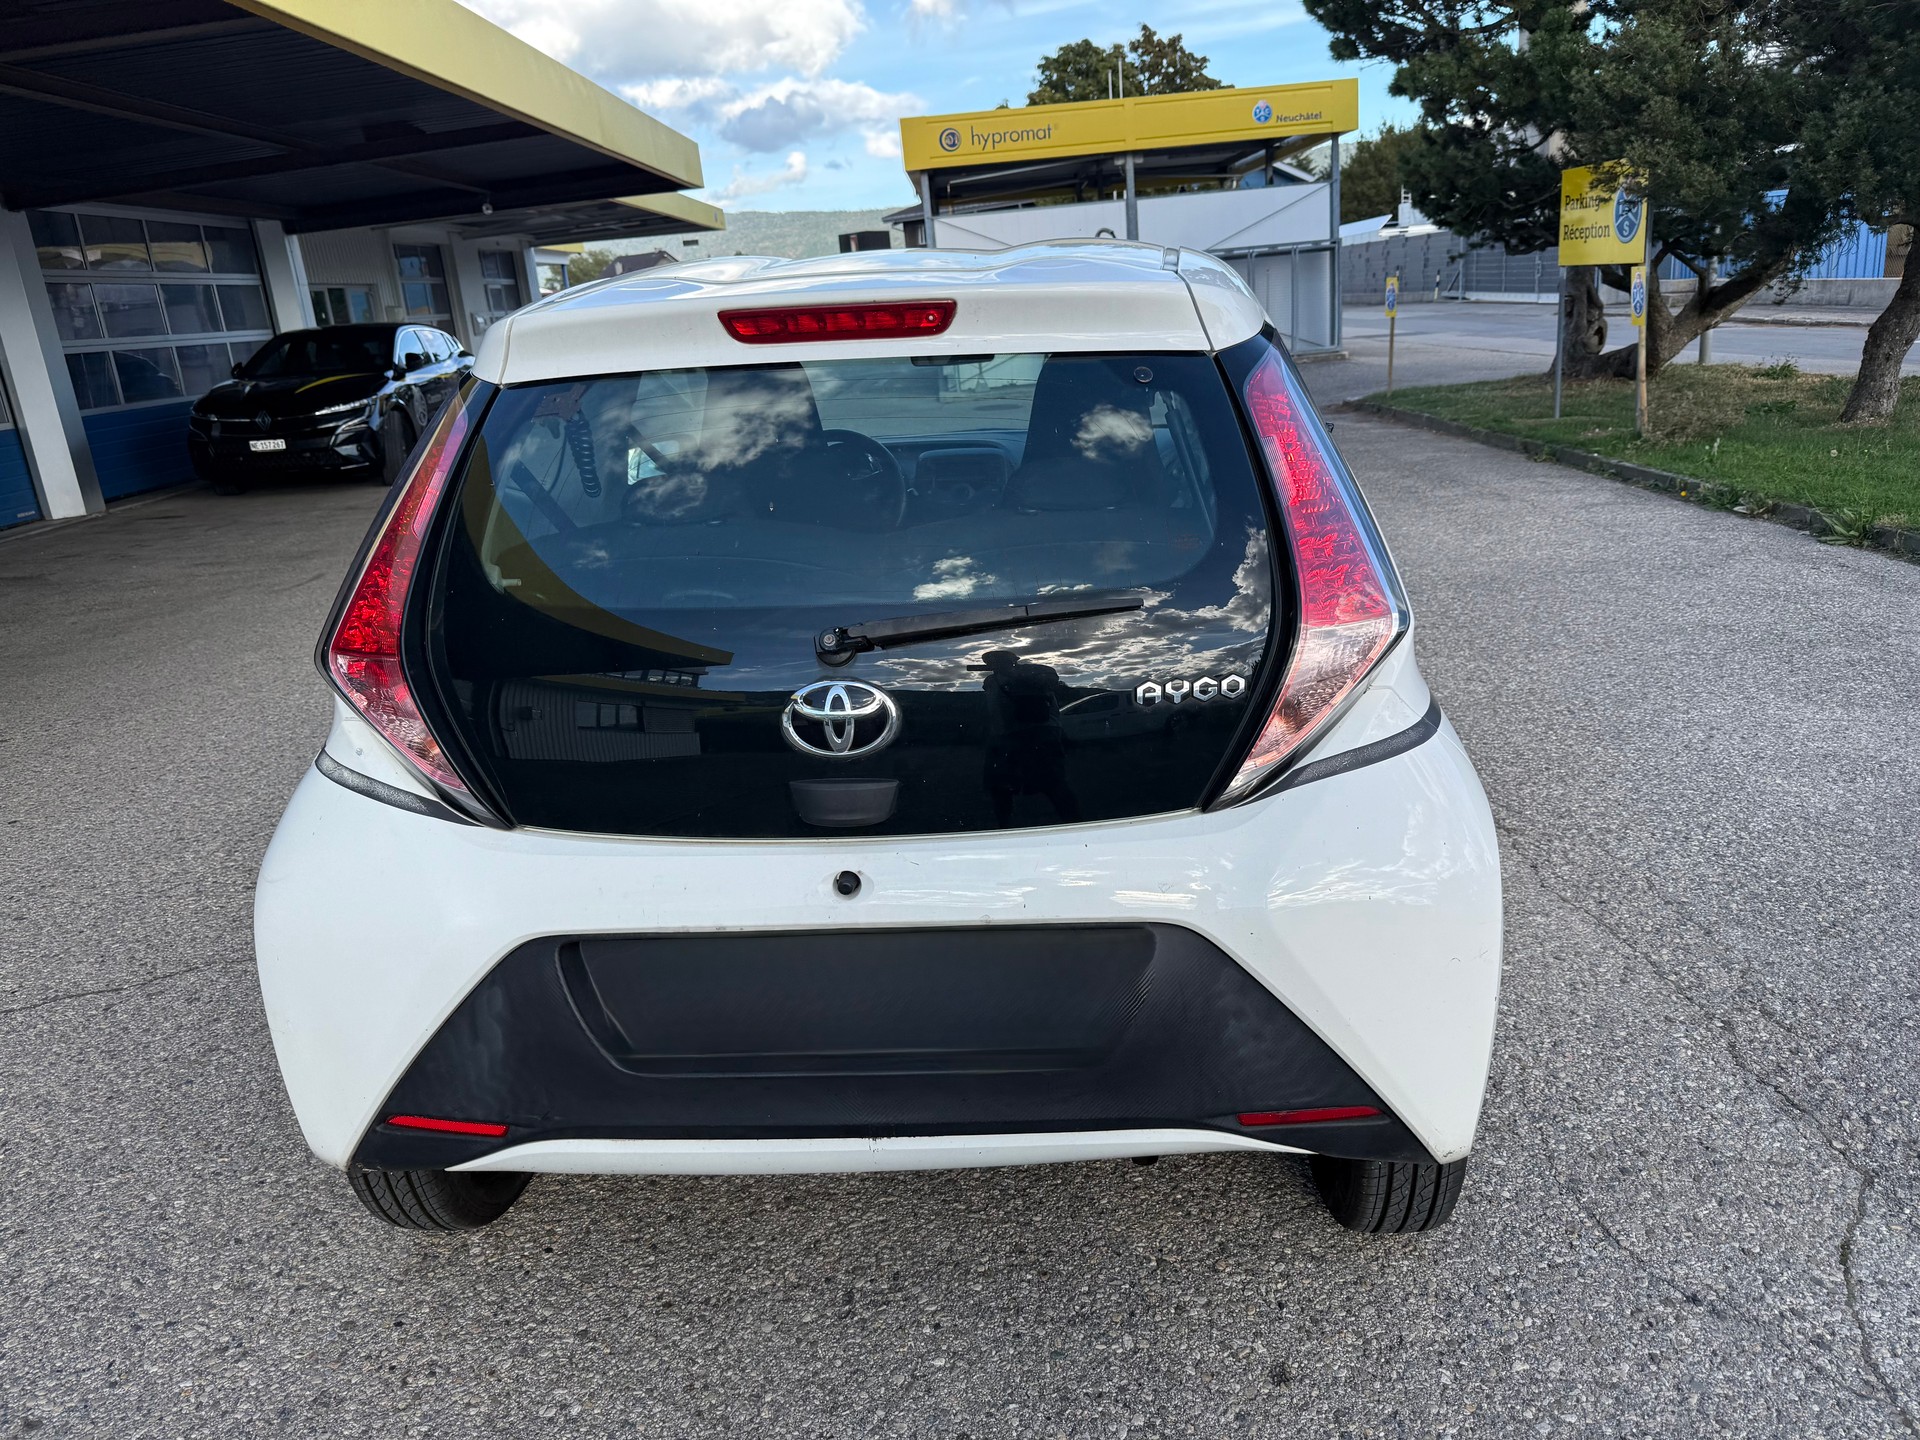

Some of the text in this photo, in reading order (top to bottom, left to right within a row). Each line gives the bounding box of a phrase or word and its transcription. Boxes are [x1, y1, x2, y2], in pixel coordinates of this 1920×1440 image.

[1276, 111, 1322, 123] Neuchâtel
[970, 124, 1052, 151] hypromat
[1565, 193, 1600, 212] Parking
[1563, 222, 1611, 243] Réception
[1136, 674, 1246, 705] AYGO
